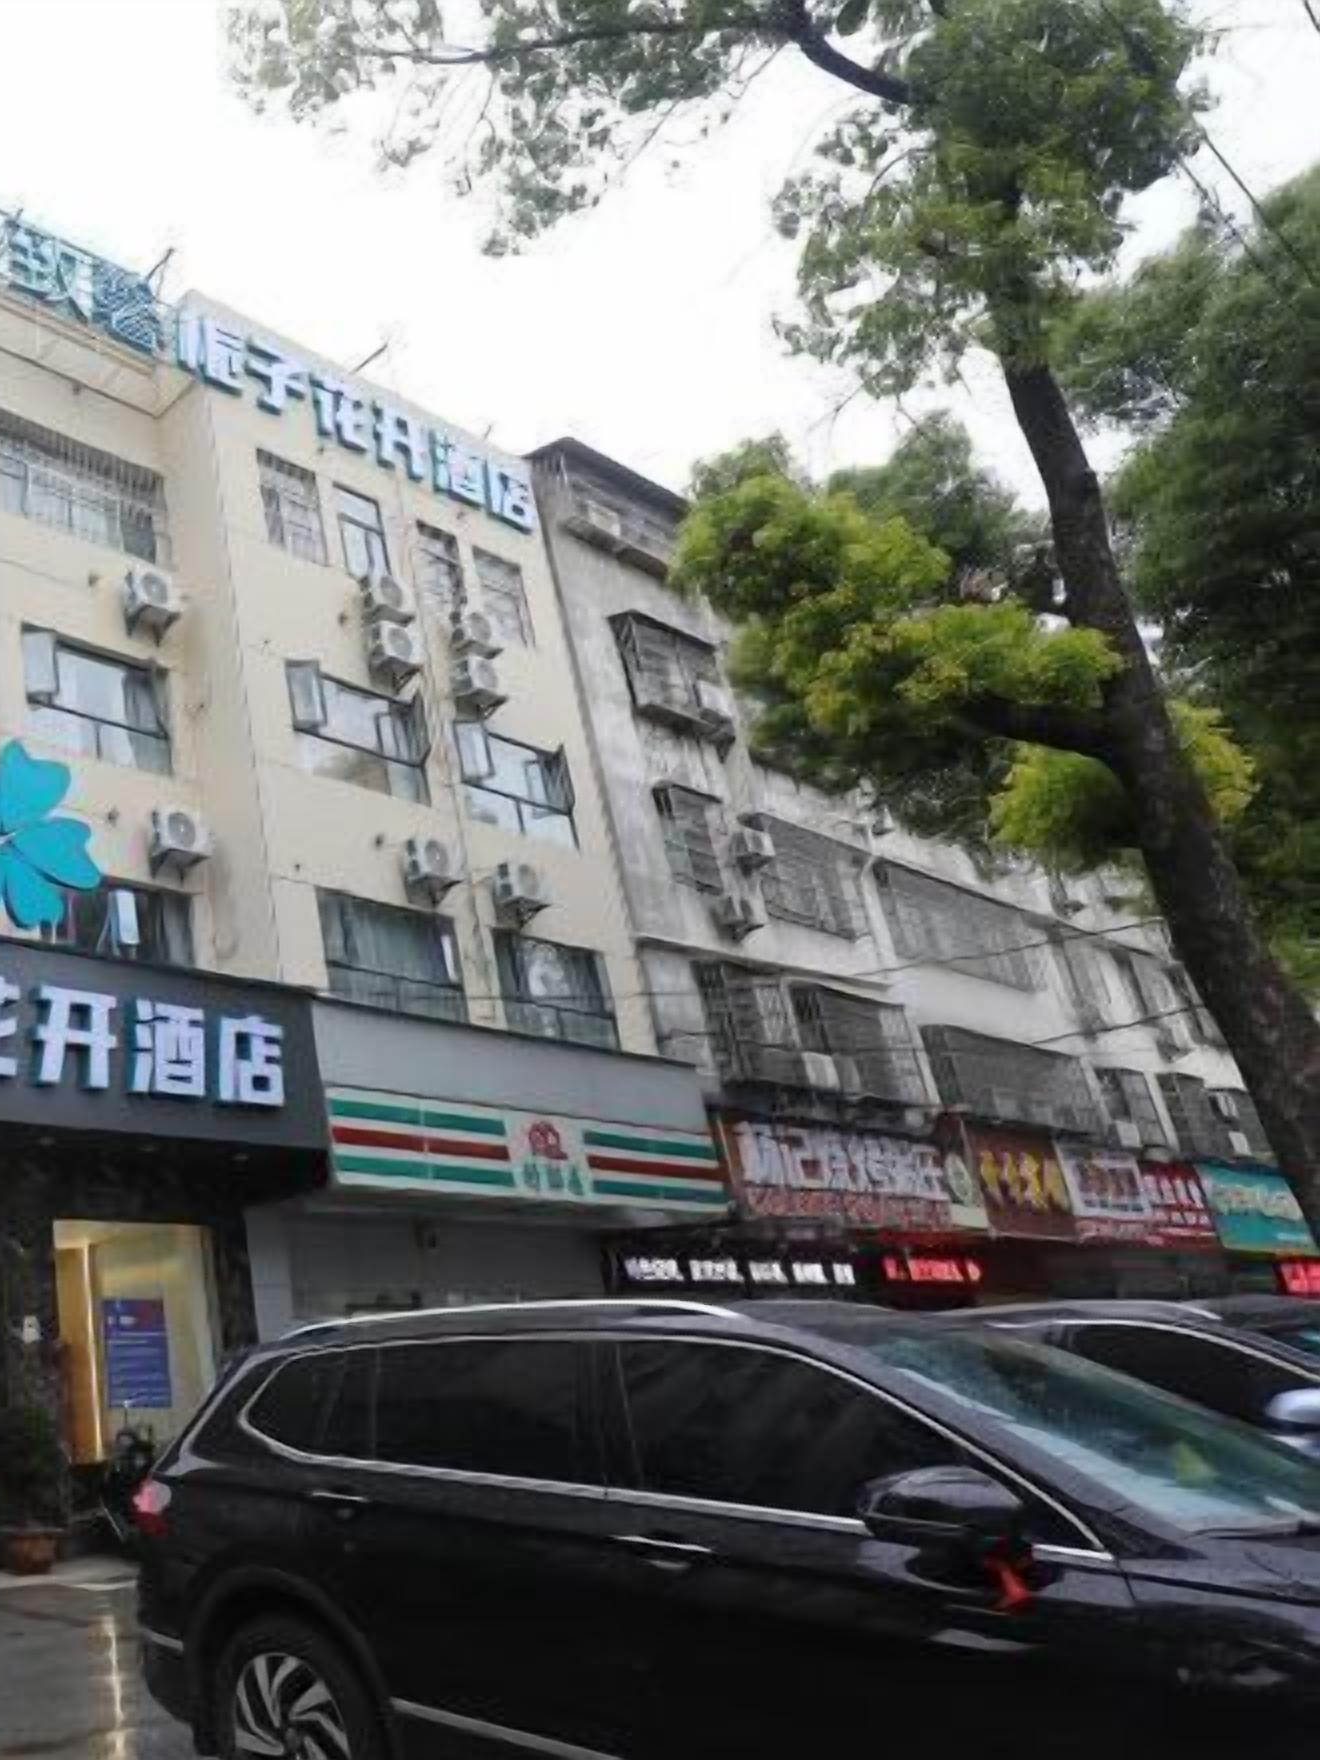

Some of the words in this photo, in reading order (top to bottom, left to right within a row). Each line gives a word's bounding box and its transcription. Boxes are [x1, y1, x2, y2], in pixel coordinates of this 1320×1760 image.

[177, 309, 533, 534] 栀子花开酒店
